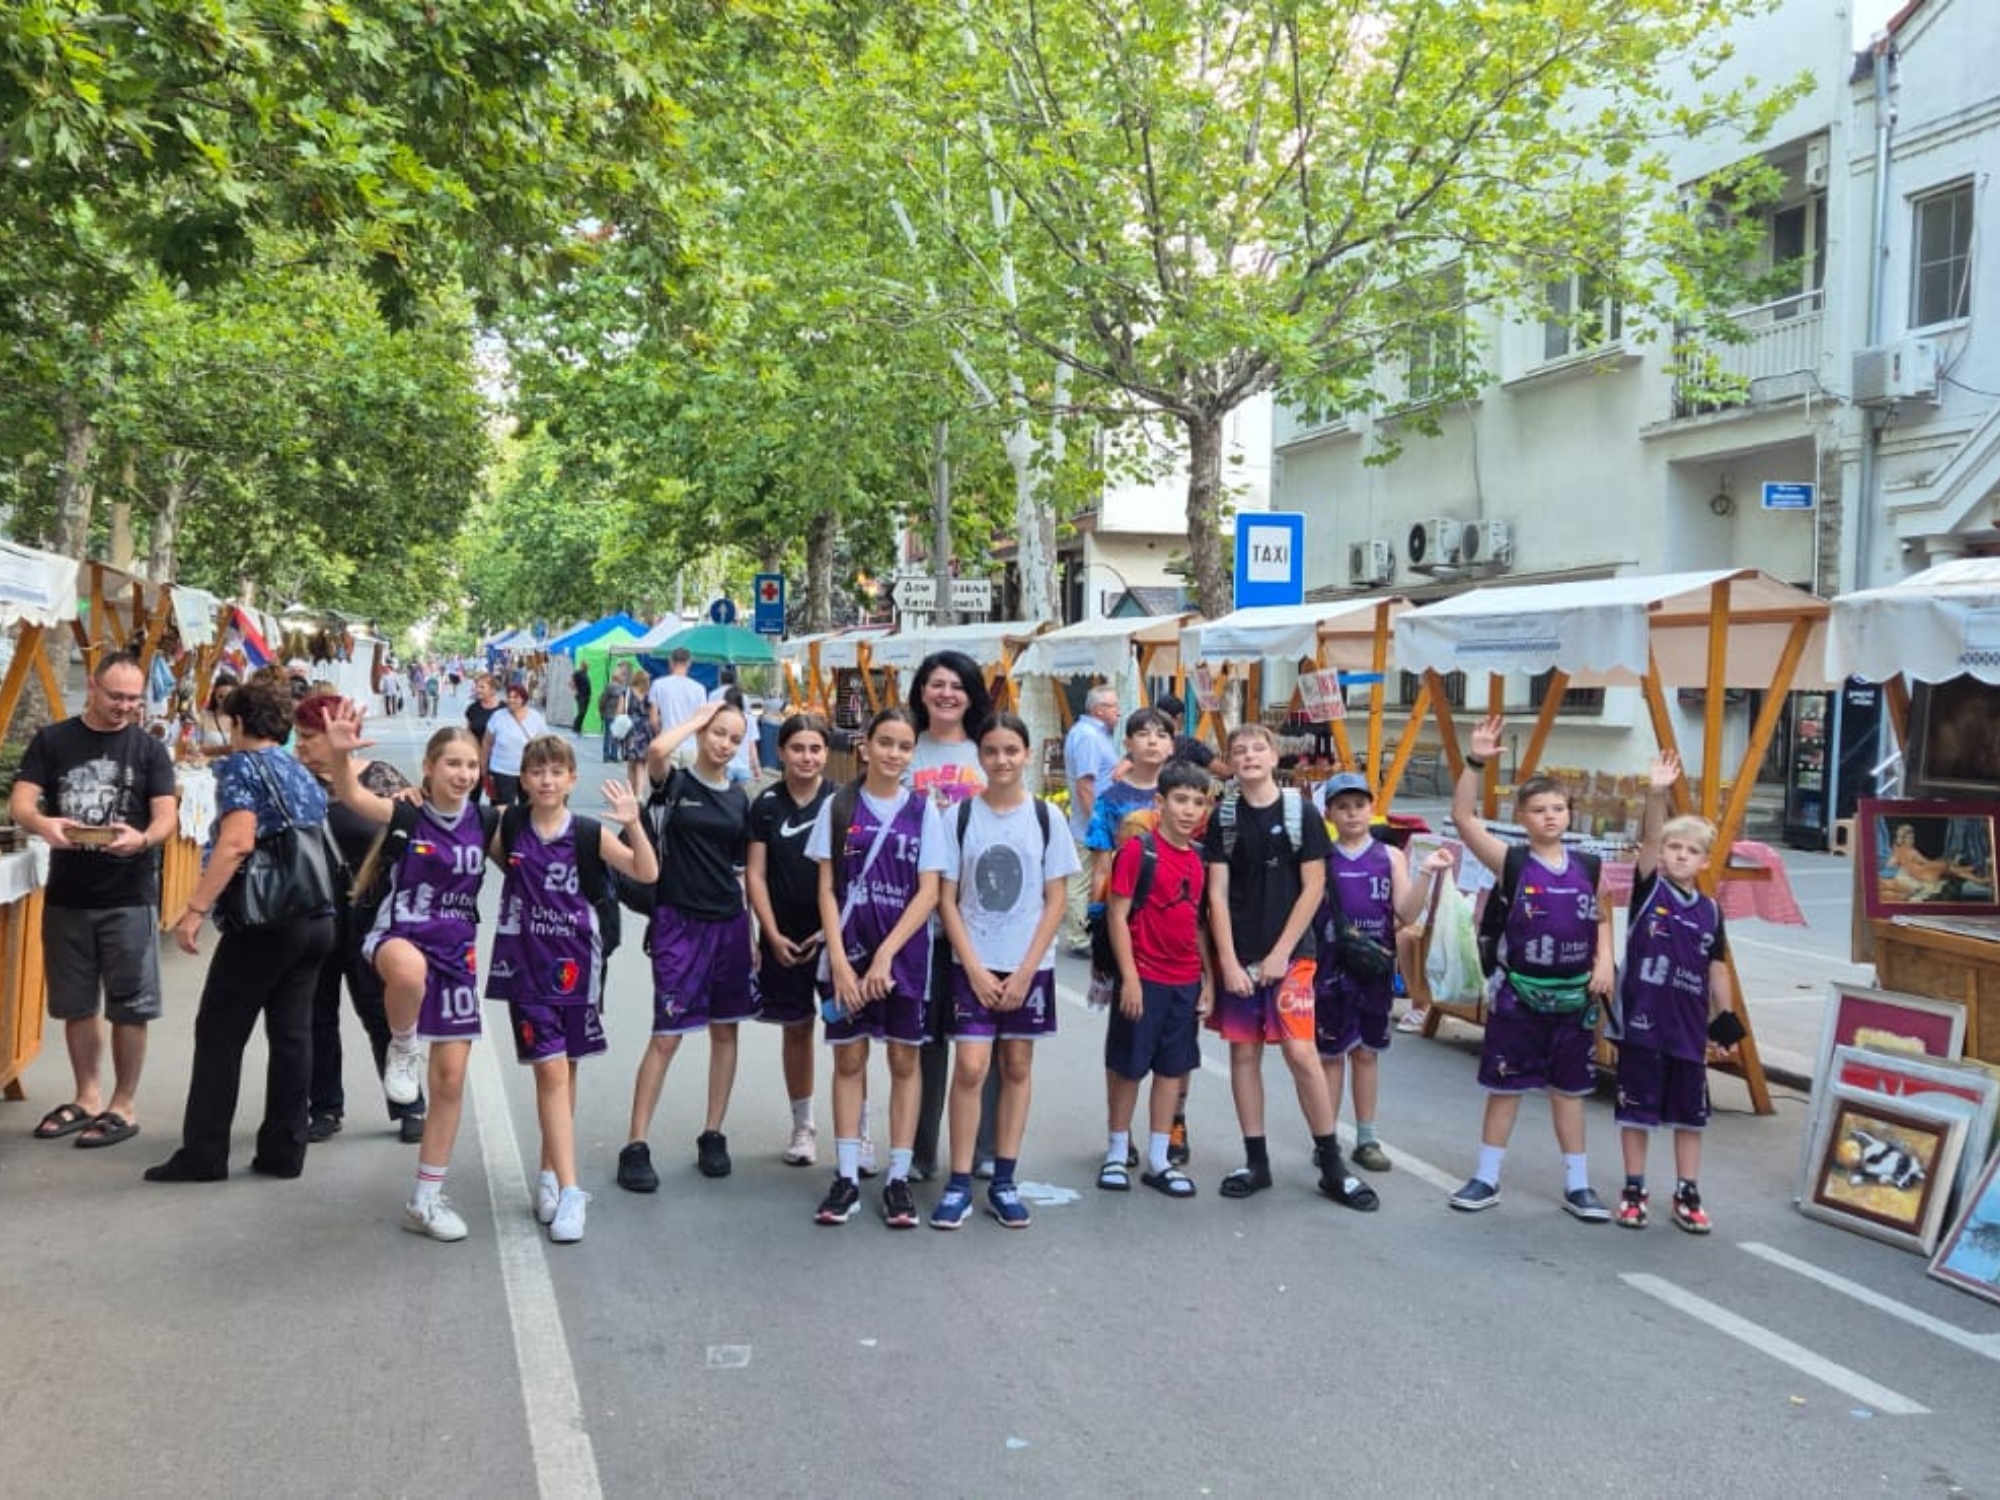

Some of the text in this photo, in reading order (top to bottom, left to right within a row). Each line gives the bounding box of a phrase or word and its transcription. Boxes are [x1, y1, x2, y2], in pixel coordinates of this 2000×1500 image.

[1252, 544, 1288, 564] TAXI
[453, 845, 482, 875] 10
[545, 862, 579, 894] 26
[1370, 876, 1390, 900] 19
[531, 904, 578, 925] Urban
[441, 986, 475, 1019] 10
[1027, 986, 1046, 1015] 4
